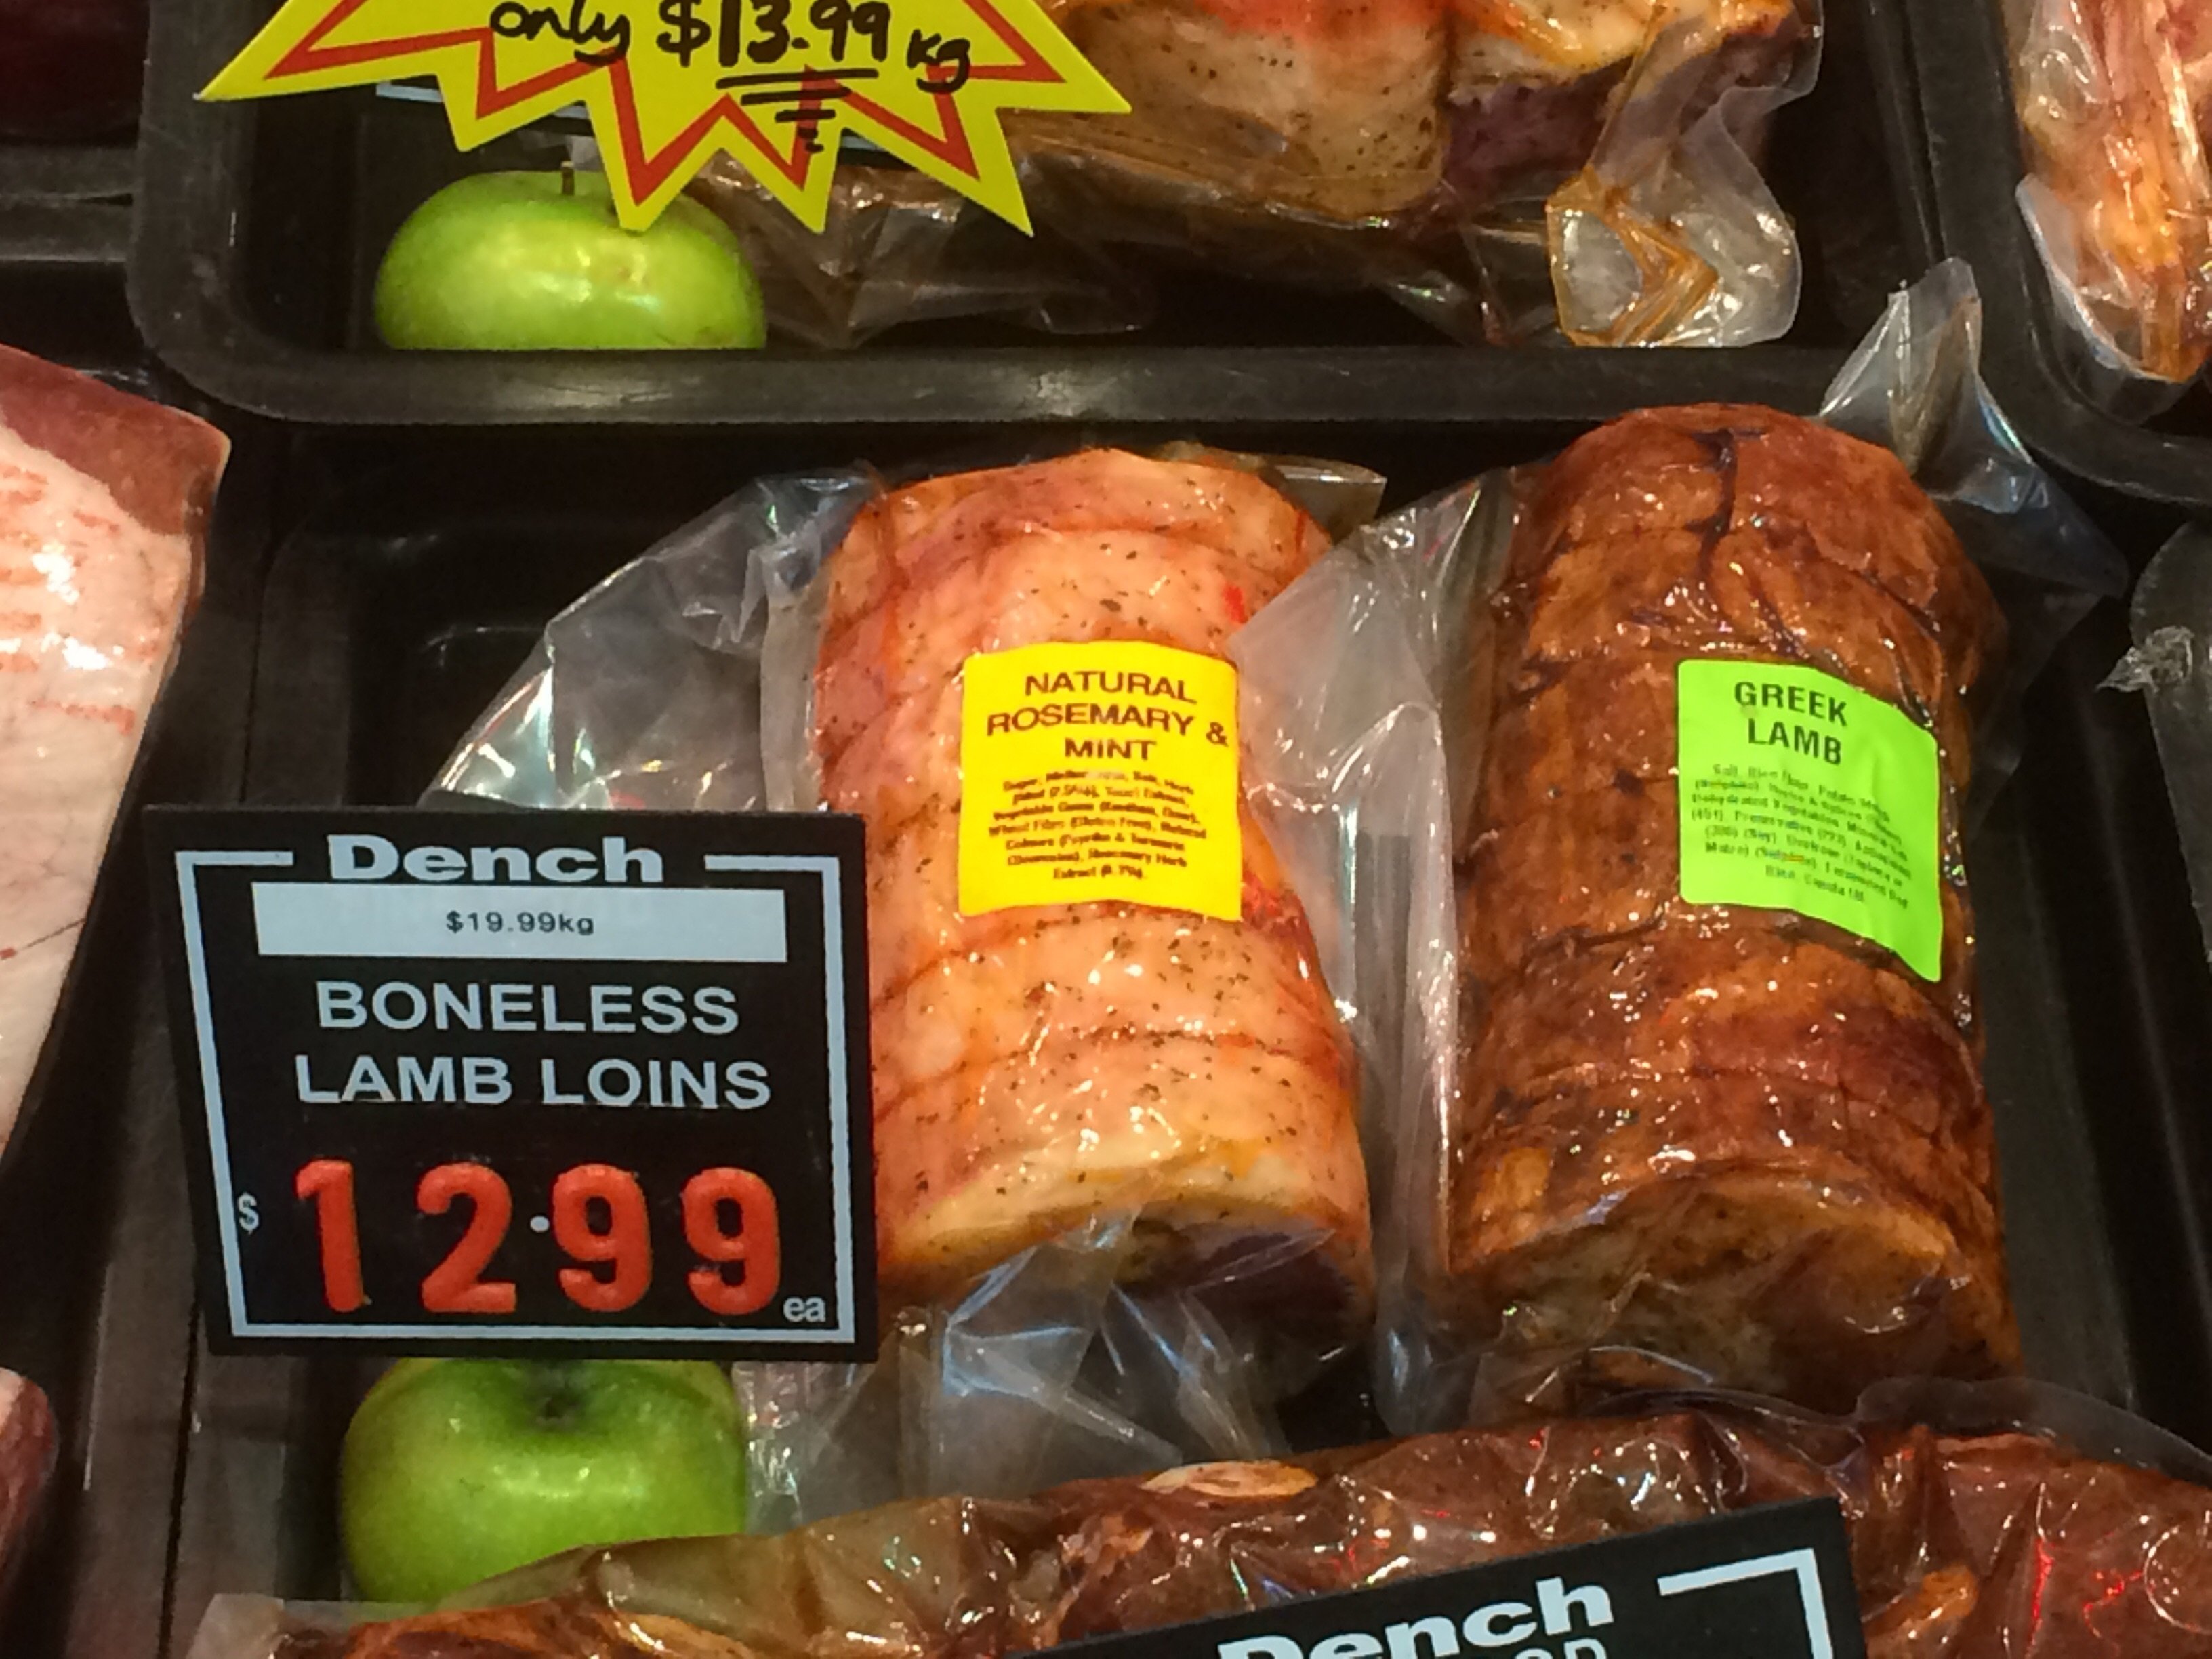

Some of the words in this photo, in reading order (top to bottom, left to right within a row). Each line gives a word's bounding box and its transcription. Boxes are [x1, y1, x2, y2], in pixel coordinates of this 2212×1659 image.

[489, 0, 631, 65] only
[655, 0, 891, 67] $13.99
[906, 29, 971, 94] kg
[1025, 670, 1197, 704] NATURAL
[1734, 681, 1848, 727] GREEK
[986, 703, 1194, 737] ROSEMARY
[1205, 721, 1229, 747] &
[1064, 737, 1157, 761] MINT
[1747, 718, 1842, 766] LAMB
[326, 834, 664, 882] Dench
[445, 909, 595, 937] $19.99kg
[315, 980, 740, 1035] BONELESS
[293, 1054, 514, 1105] LAMB
[541, 1058, 772, 1110] LOINS
[237, 1192, 260, 1235] $
[783, 1294, 827, 1324] ea
